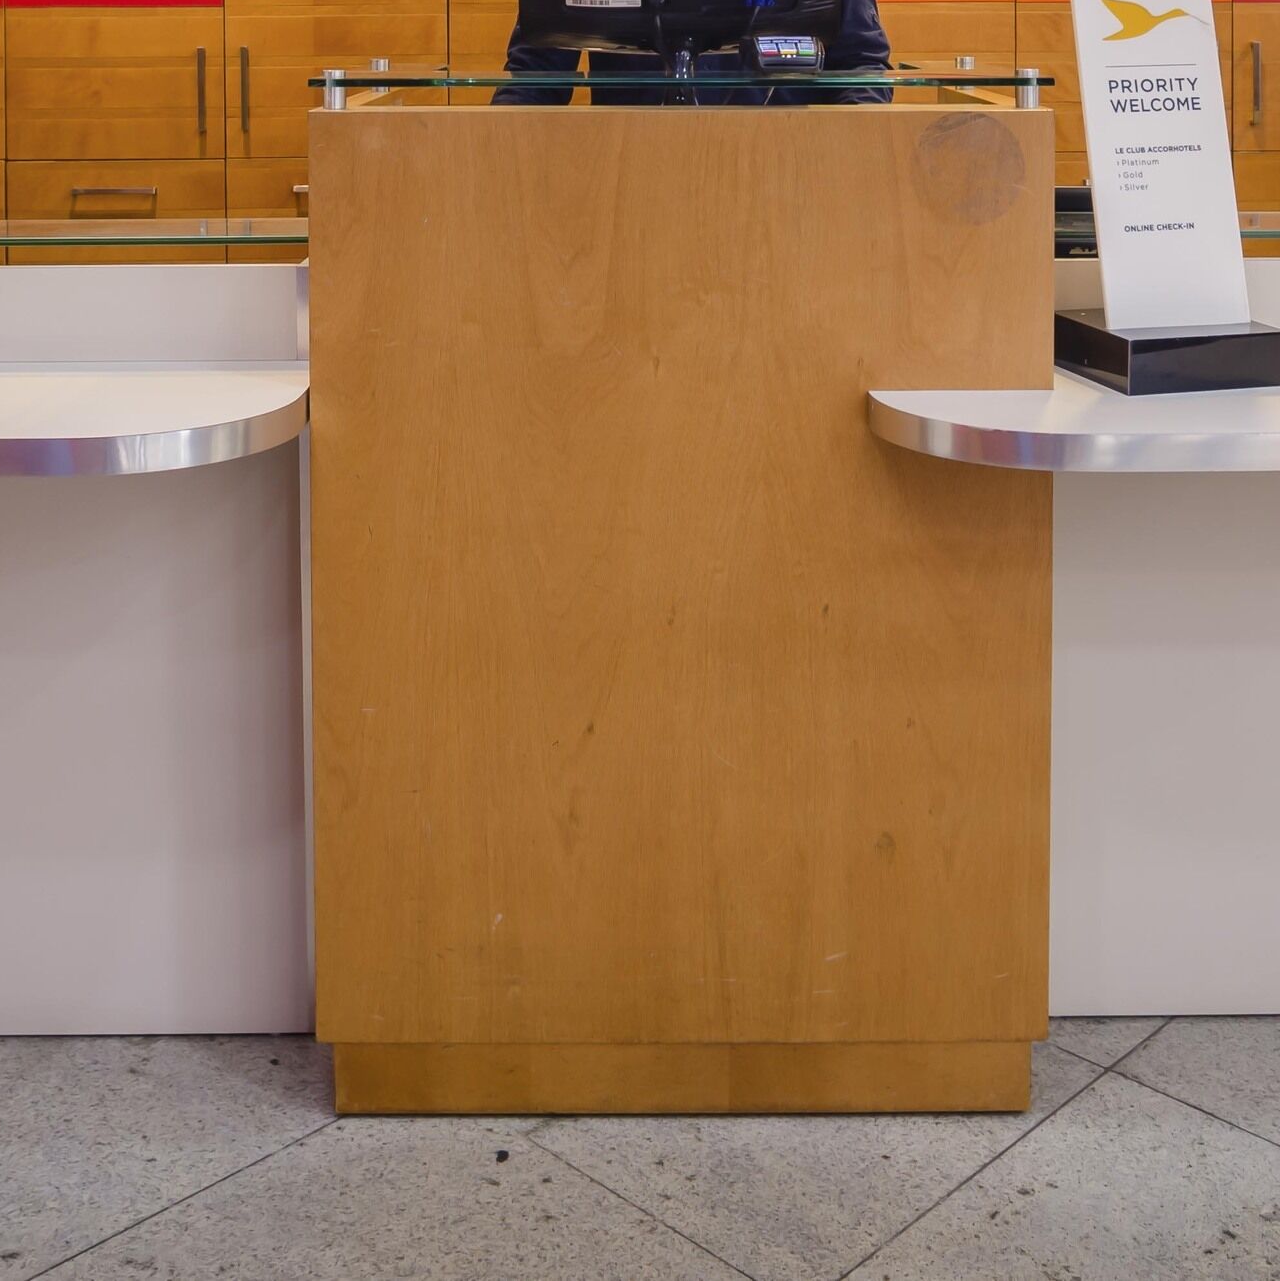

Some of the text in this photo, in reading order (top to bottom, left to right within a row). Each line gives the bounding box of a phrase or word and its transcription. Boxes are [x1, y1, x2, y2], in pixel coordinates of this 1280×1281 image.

[1108, 78, 1198, 94] PRIORITY
[1110, 97, 1202, 114] WELCOME
[1147, 145, 1202, 153] ACCORHOTELS
[1121, 159, 1160, 167] Platinum
[1123, 171, 1143, 179] Gold
[1124, 183, 1149, 191] Silver
[1124, 222, 1195, 233] ONLINE CHECK-IN
